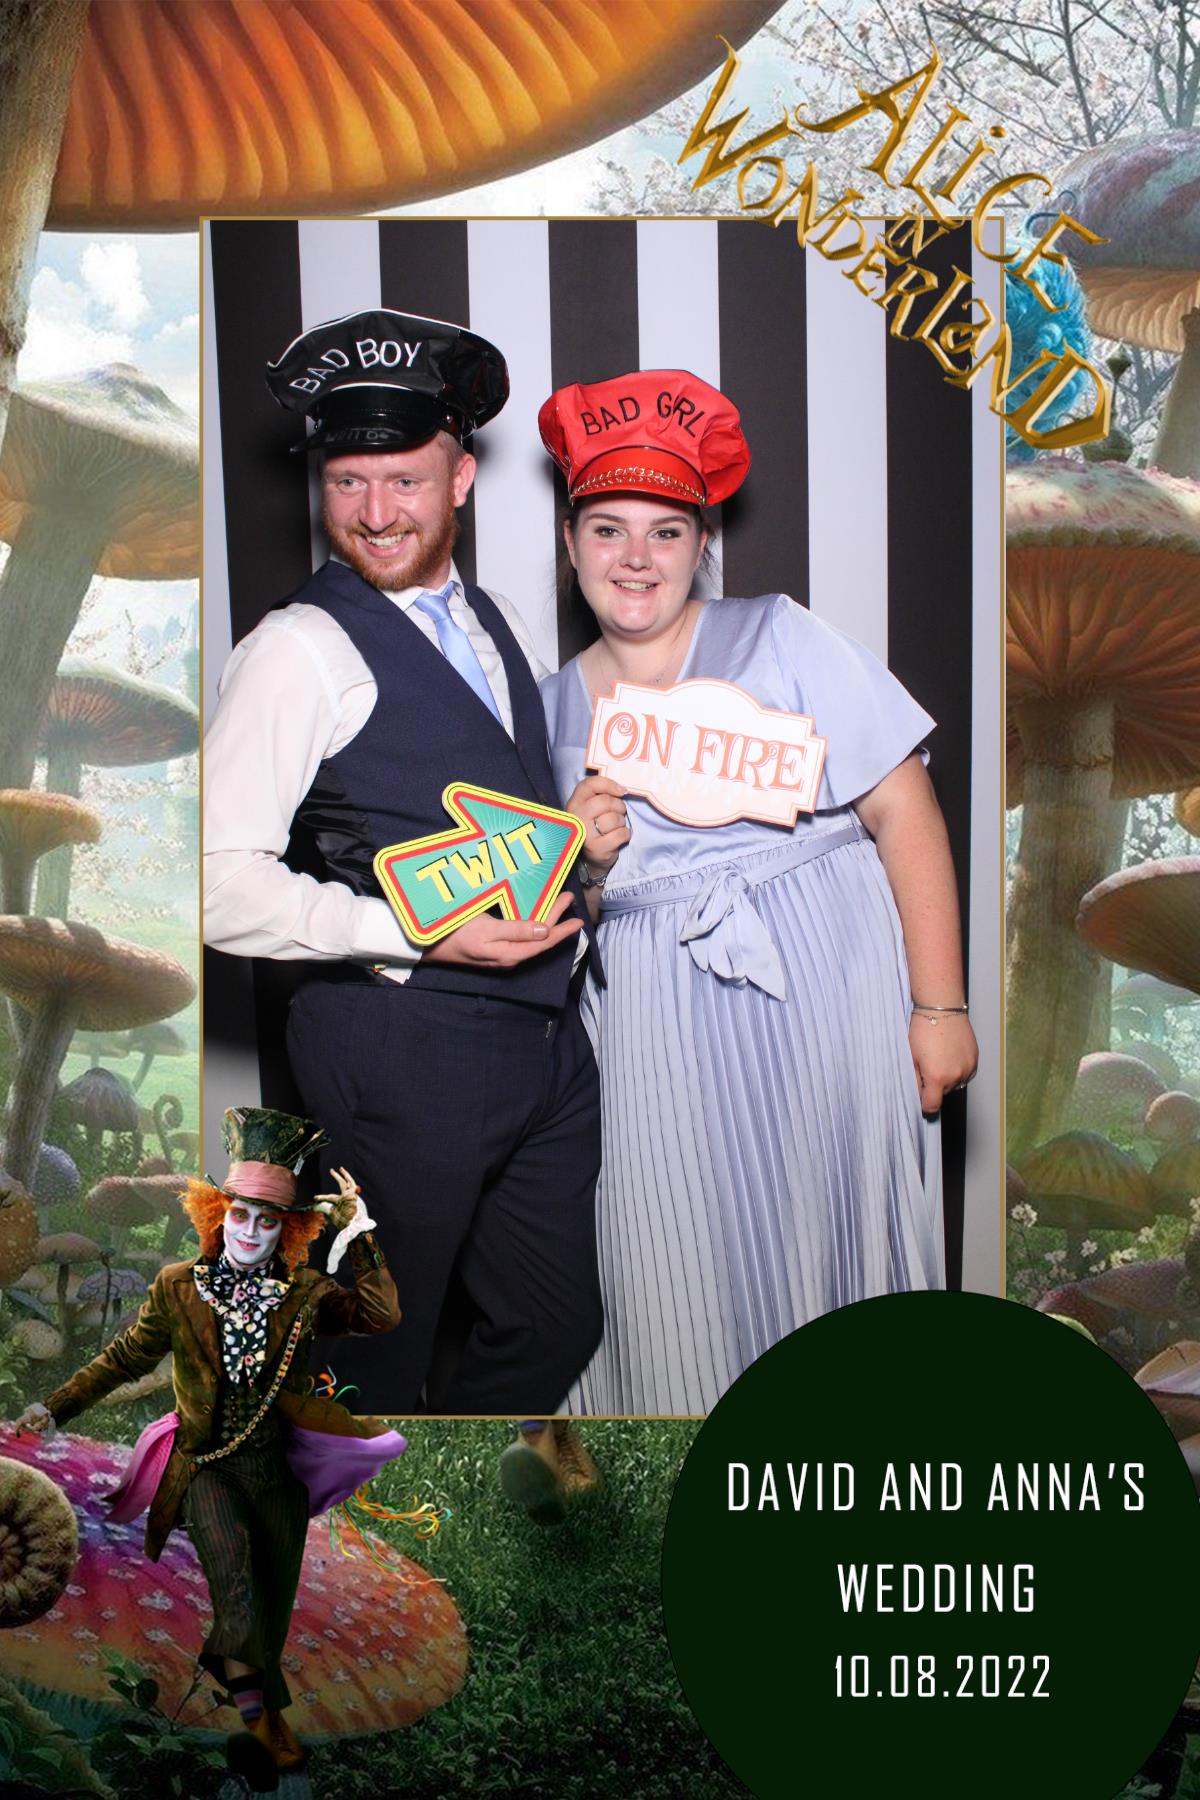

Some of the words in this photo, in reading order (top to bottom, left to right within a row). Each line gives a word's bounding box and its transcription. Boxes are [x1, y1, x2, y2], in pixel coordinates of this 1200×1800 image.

[289, 348, 350, 394] BAD
[356, 338, 422, 369] BOY
[580, 396, 641, 436] BAD
[603, 711, 681, 769] ON
[687, 724, 807, 793] FIRE
[415, 820, 543, 903] TWIT
